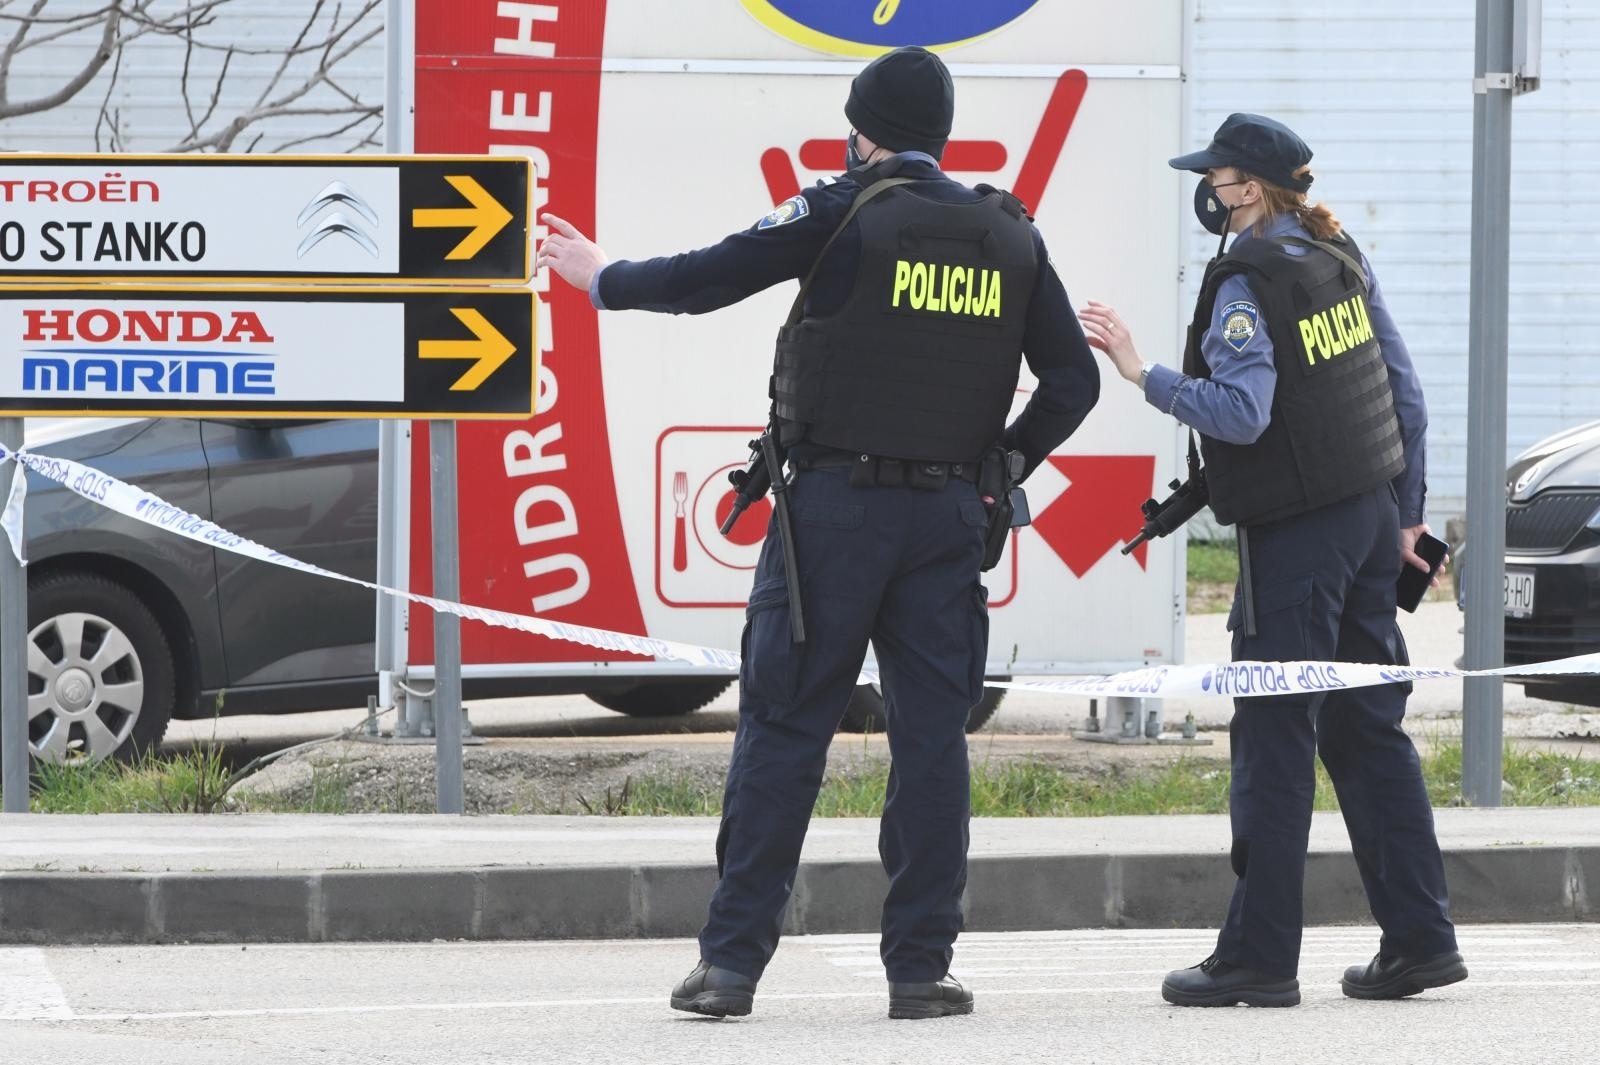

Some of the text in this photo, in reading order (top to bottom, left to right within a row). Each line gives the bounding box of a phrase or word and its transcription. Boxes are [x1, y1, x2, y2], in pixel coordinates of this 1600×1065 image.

[0, 221, 206, 262] O STANKO
[892, 260, 1001, 318] POLICIJA
[23, 309, 274, 343] HONDA
[1222, 304, 1257, 318] POLICIJA
[1298, 294, 1374, 366] POLICIJA
[22, 358, 275, 395] MARINE
[73, 470, 114, 501] STOP
[204, 529, 243, 547] STOP
[1215, 665, 1348, 694] STOP POLICIJA
